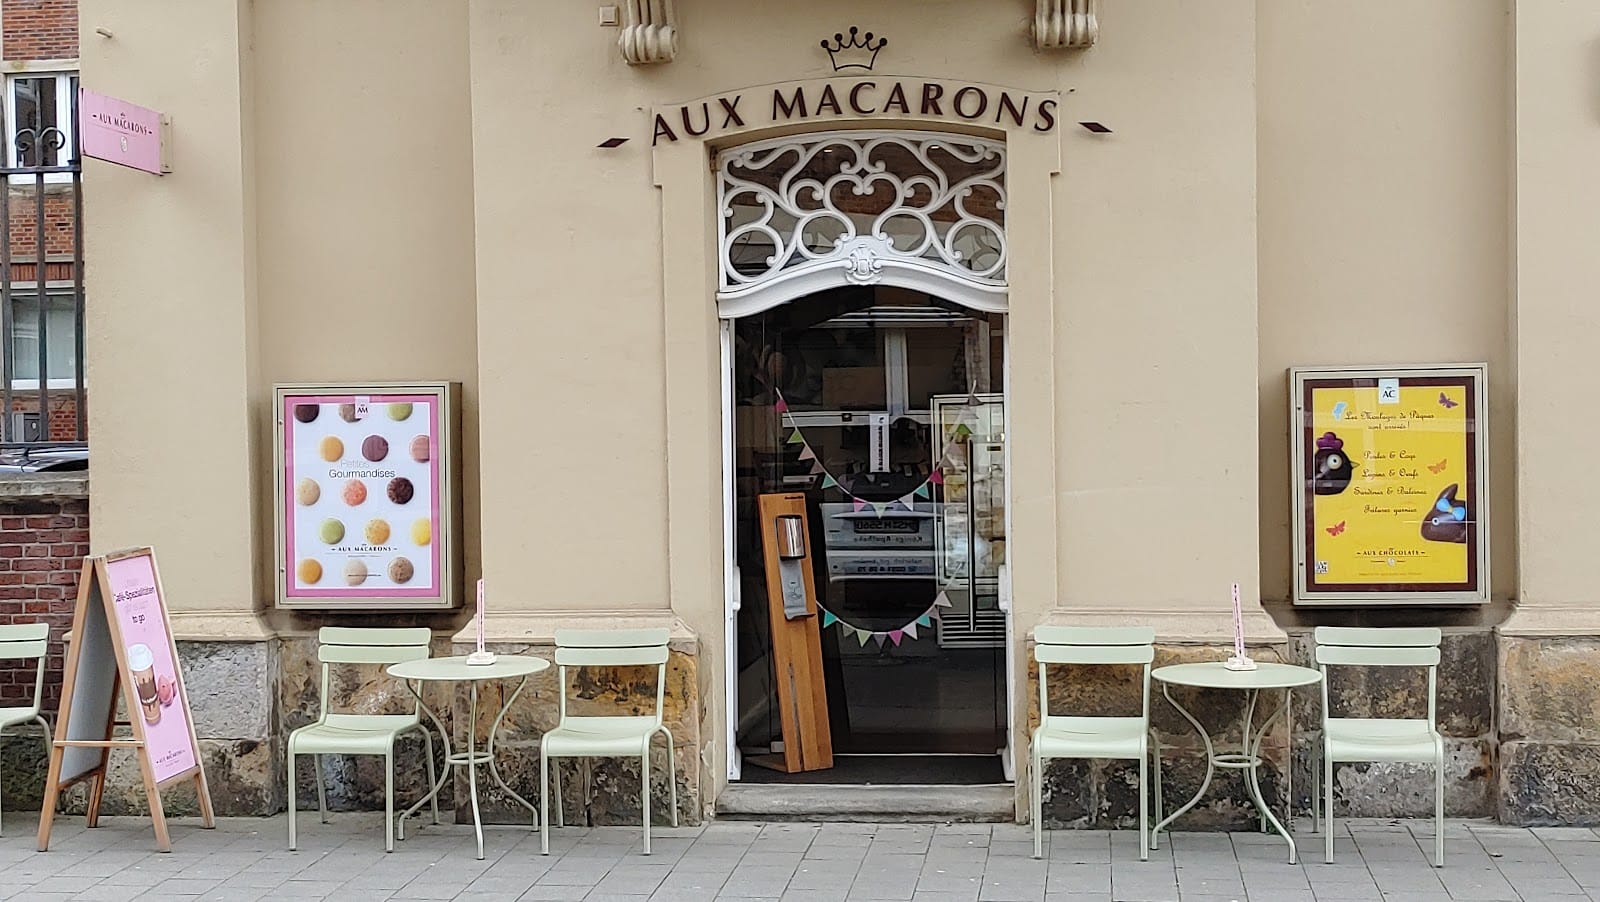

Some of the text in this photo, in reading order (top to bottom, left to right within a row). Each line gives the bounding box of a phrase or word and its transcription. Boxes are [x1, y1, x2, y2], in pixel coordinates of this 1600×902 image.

[652, 81, 1058, 147] AUX MACARONS
[99, 113, 147, 136] AUX MACARONS
[1382, 389, 1395, 398] AC
[341, 460, 370, 469] Petites
[328, 469, 396, 479] Gourmandises
